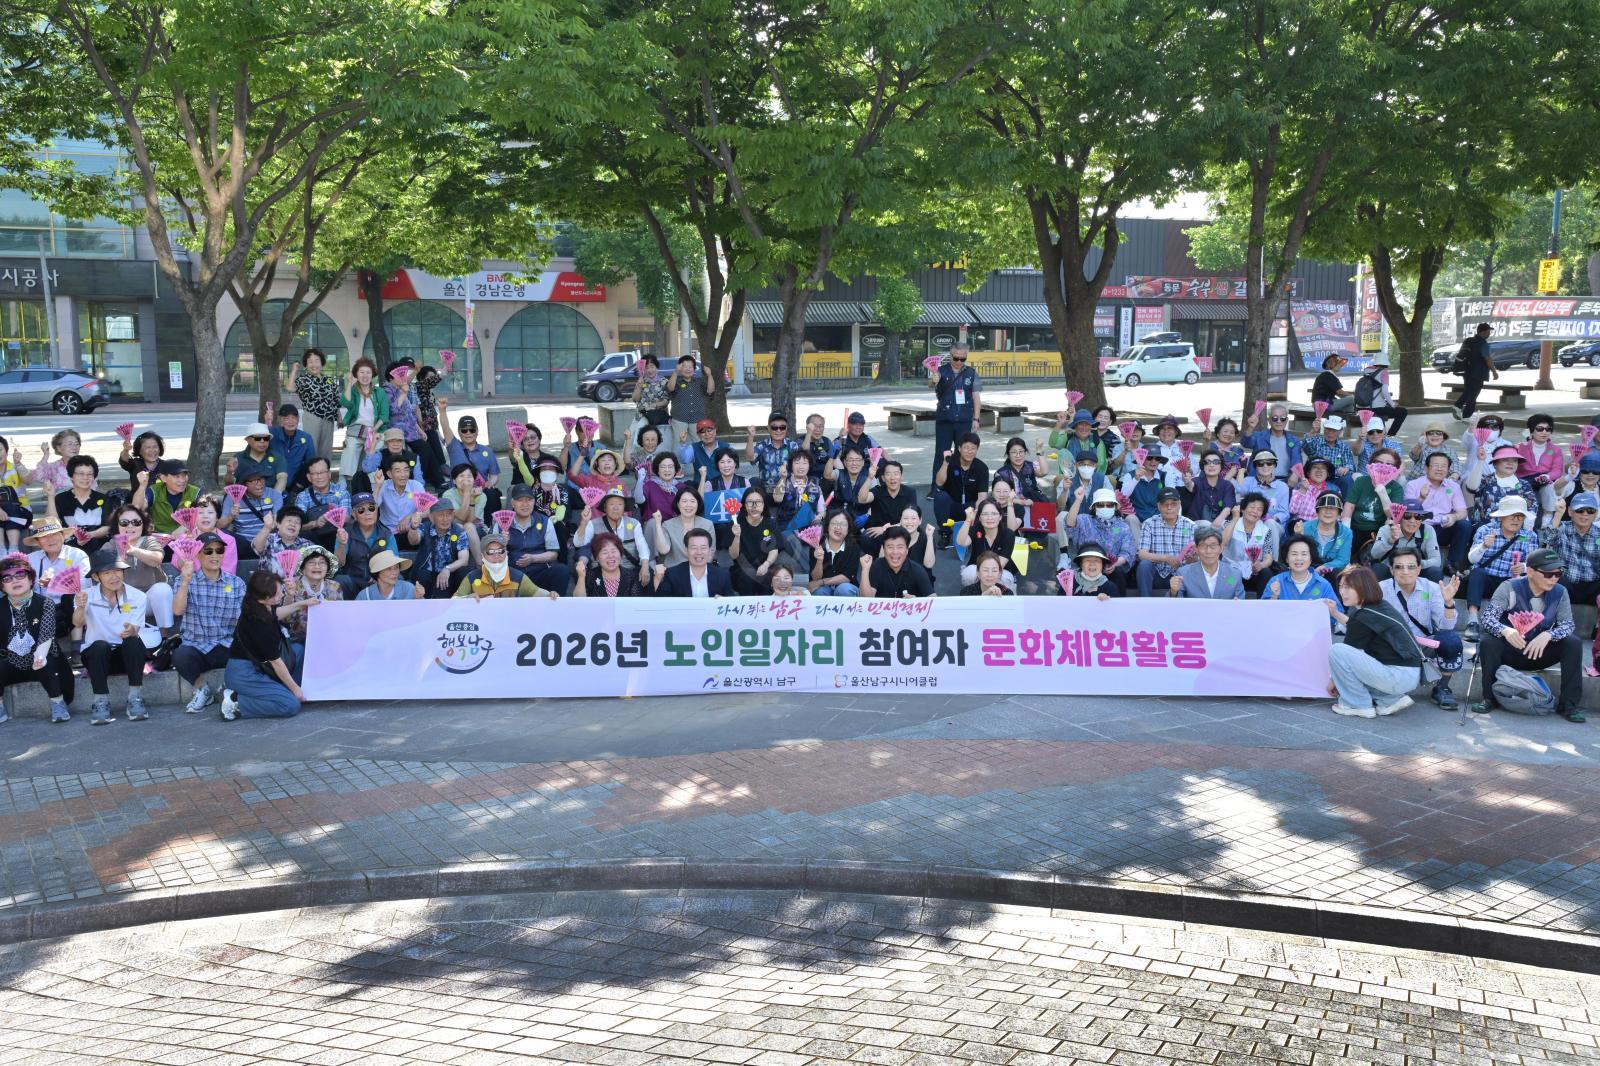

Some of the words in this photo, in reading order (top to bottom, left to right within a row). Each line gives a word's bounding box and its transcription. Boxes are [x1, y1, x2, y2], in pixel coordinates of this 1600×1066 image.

[475, 283, 526, 298] 경남은행
[1186, 278, 1212, 298] 숯불
[716, 603, 745, 617] 다시
[746, 602, 766, 619] 뛰는
[769, 599, 807, 621] 남구
[815, 603, 844, 617] 다시
[847, 602, 863, 617] 서는
[867, 597, 934, 622] 민생경제
[436, 633, 496, 661] 행복남구
[516, 629, 649, 668] 2026년
[663, 628, 843, 668] 노인일자리
[859, 628, 969, 667] 참여자
[981, 628, 1207, 670] 문화체험활동
[723, 676, 773, 688] 울산광역시
[776, 676, 797, 688] 남구
[850, 676, 938, 689] 울산남구시니어클럽
